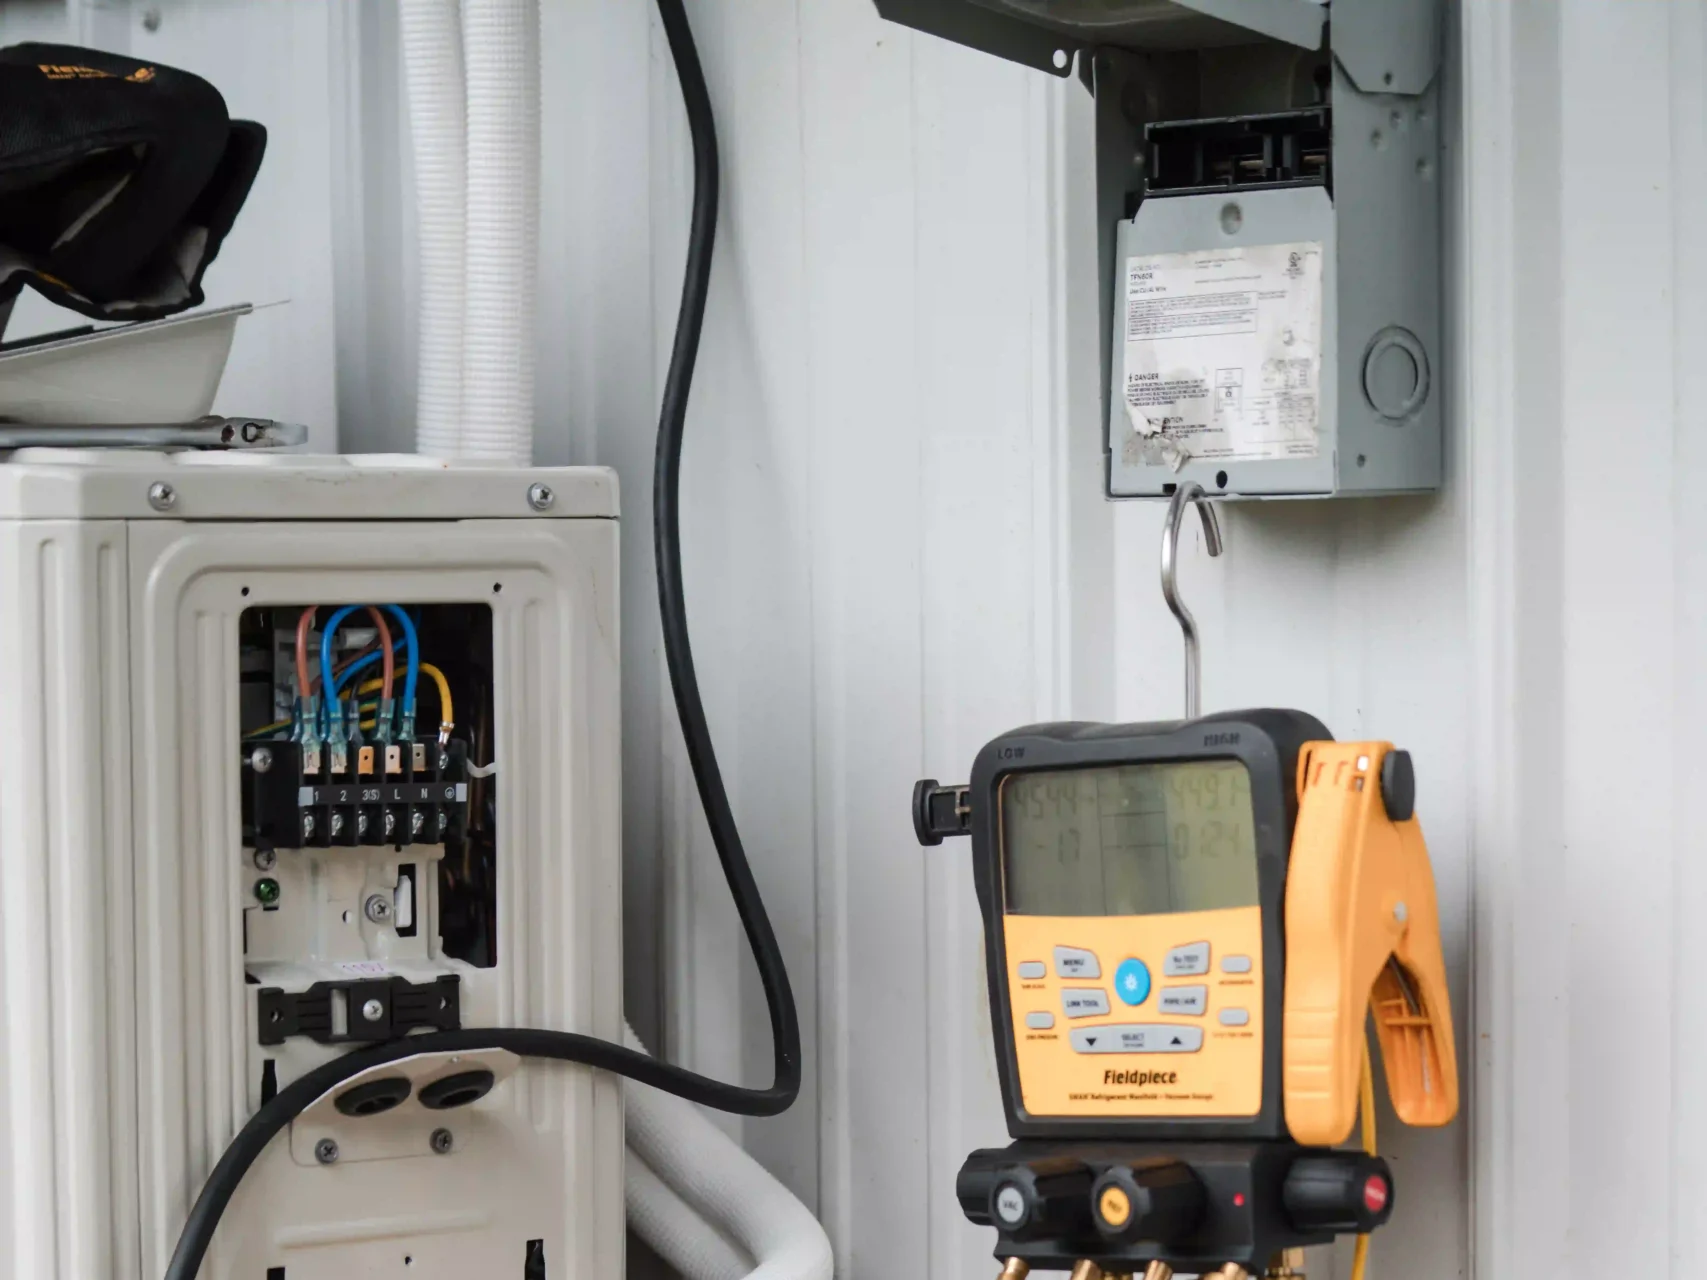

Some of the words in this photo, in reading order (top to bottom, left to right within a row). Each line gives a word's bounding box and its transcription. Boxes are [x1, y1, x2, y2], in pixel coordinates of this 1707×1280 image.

[1134, 373, 1159, 381] DANGER
[1204, 732, 1241, 746] HIGH
[997, 747, 1025, 760] LOW
[340, 789, 347, 802] 2
[362, 788, 380, 801] 3(S)
[394, 788, 401, 800] L
[420, 788, 428, 799] N
[1104, 1069, 1177, 1087] Fieldpiece
